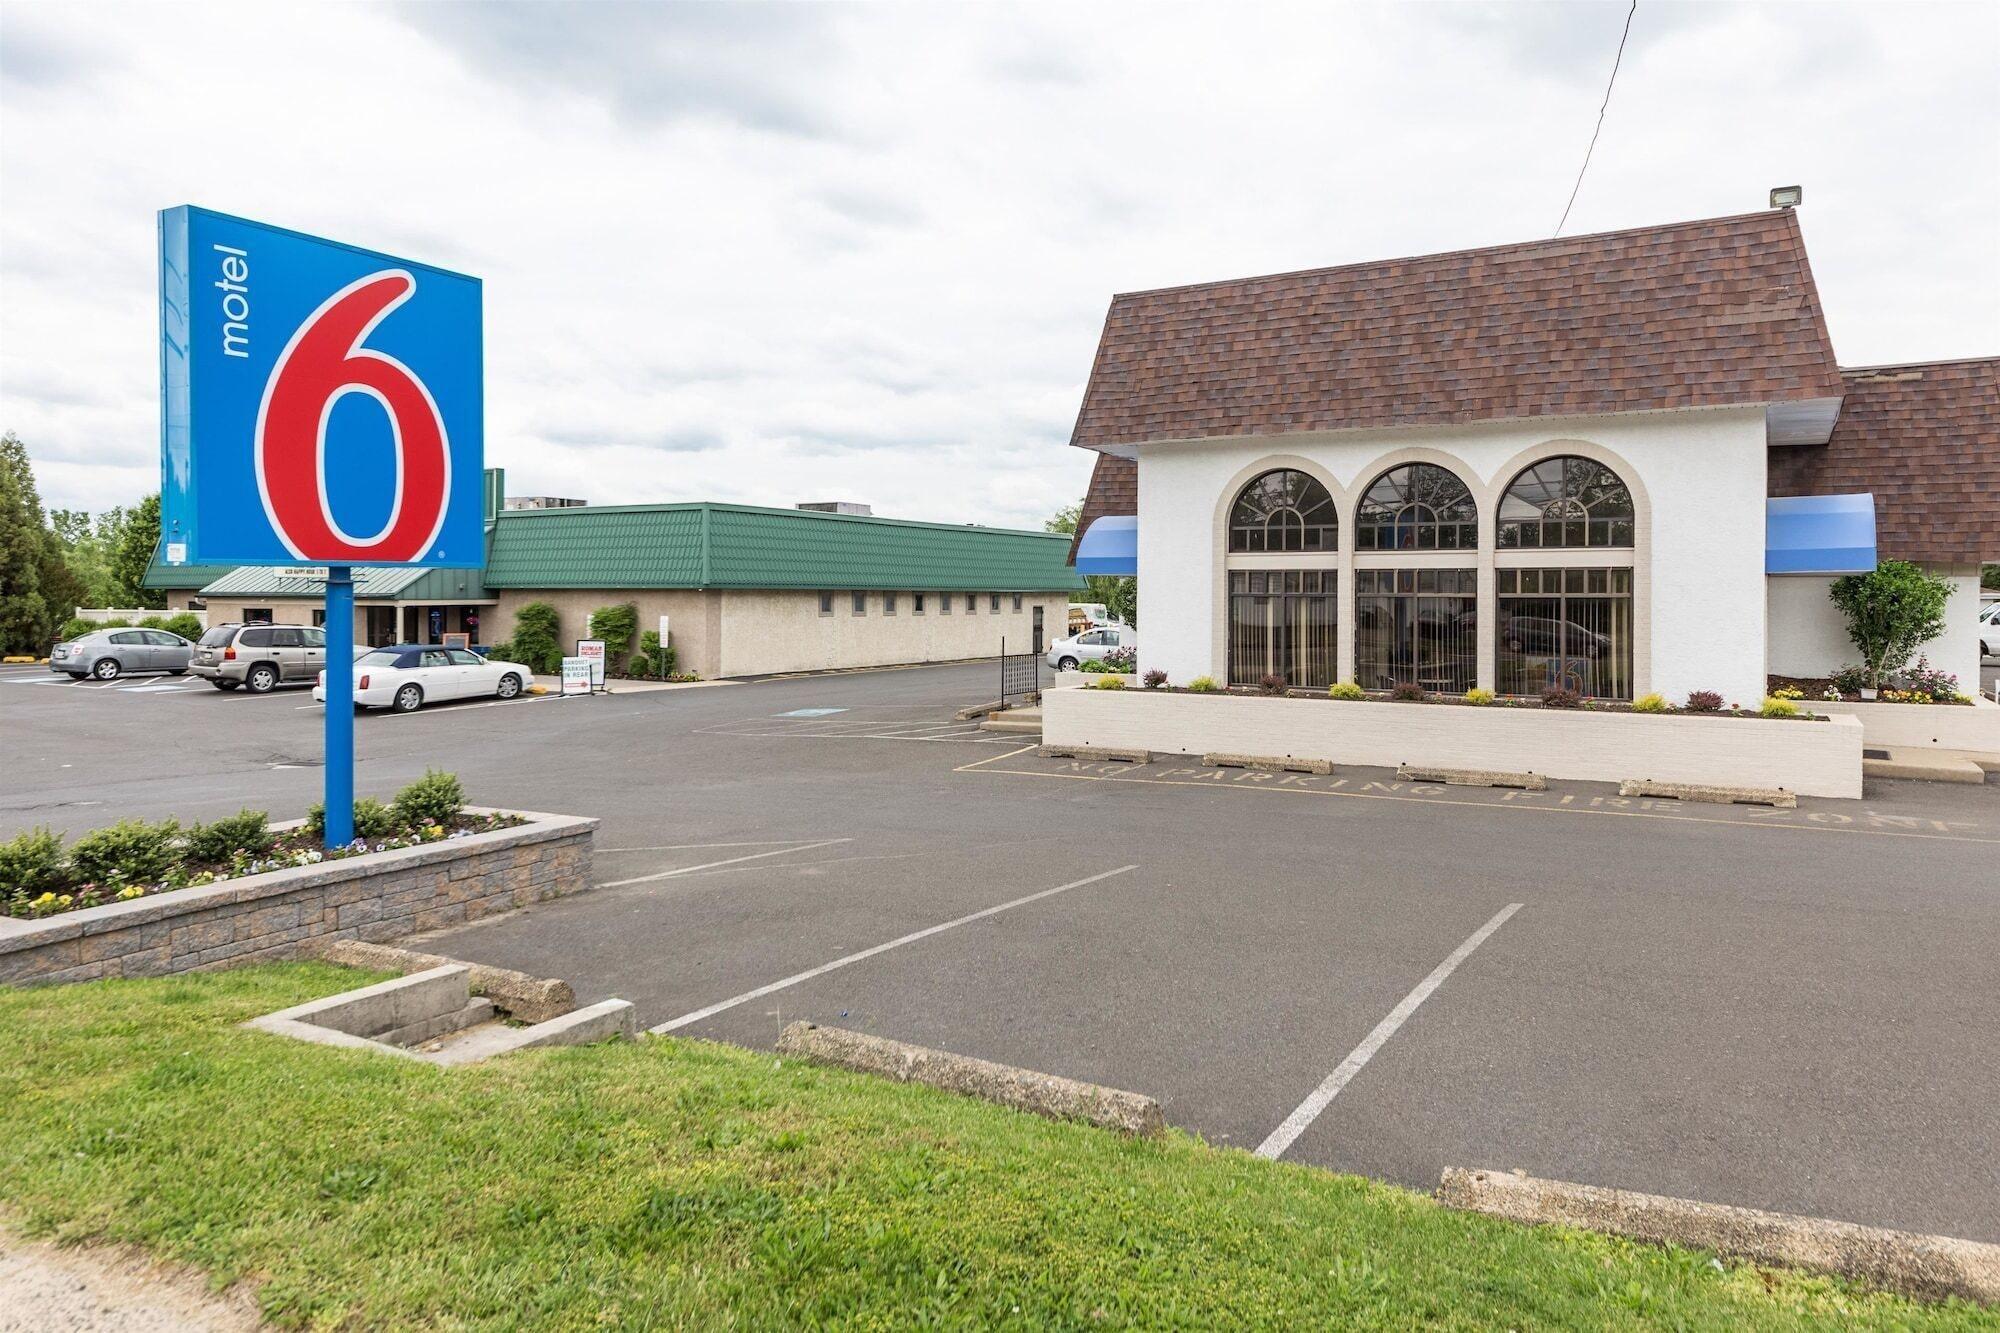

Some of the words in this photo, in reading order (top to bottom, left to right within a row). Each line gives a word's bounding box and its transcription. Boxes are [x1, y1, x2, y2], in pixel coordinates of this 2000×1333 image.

[213, 244, 249, 359] motel
[254, 268, 453, 563] 6
[1156, 768, 1448, 796] PARKING
[1503, 791, 1684, 813] FIRE
